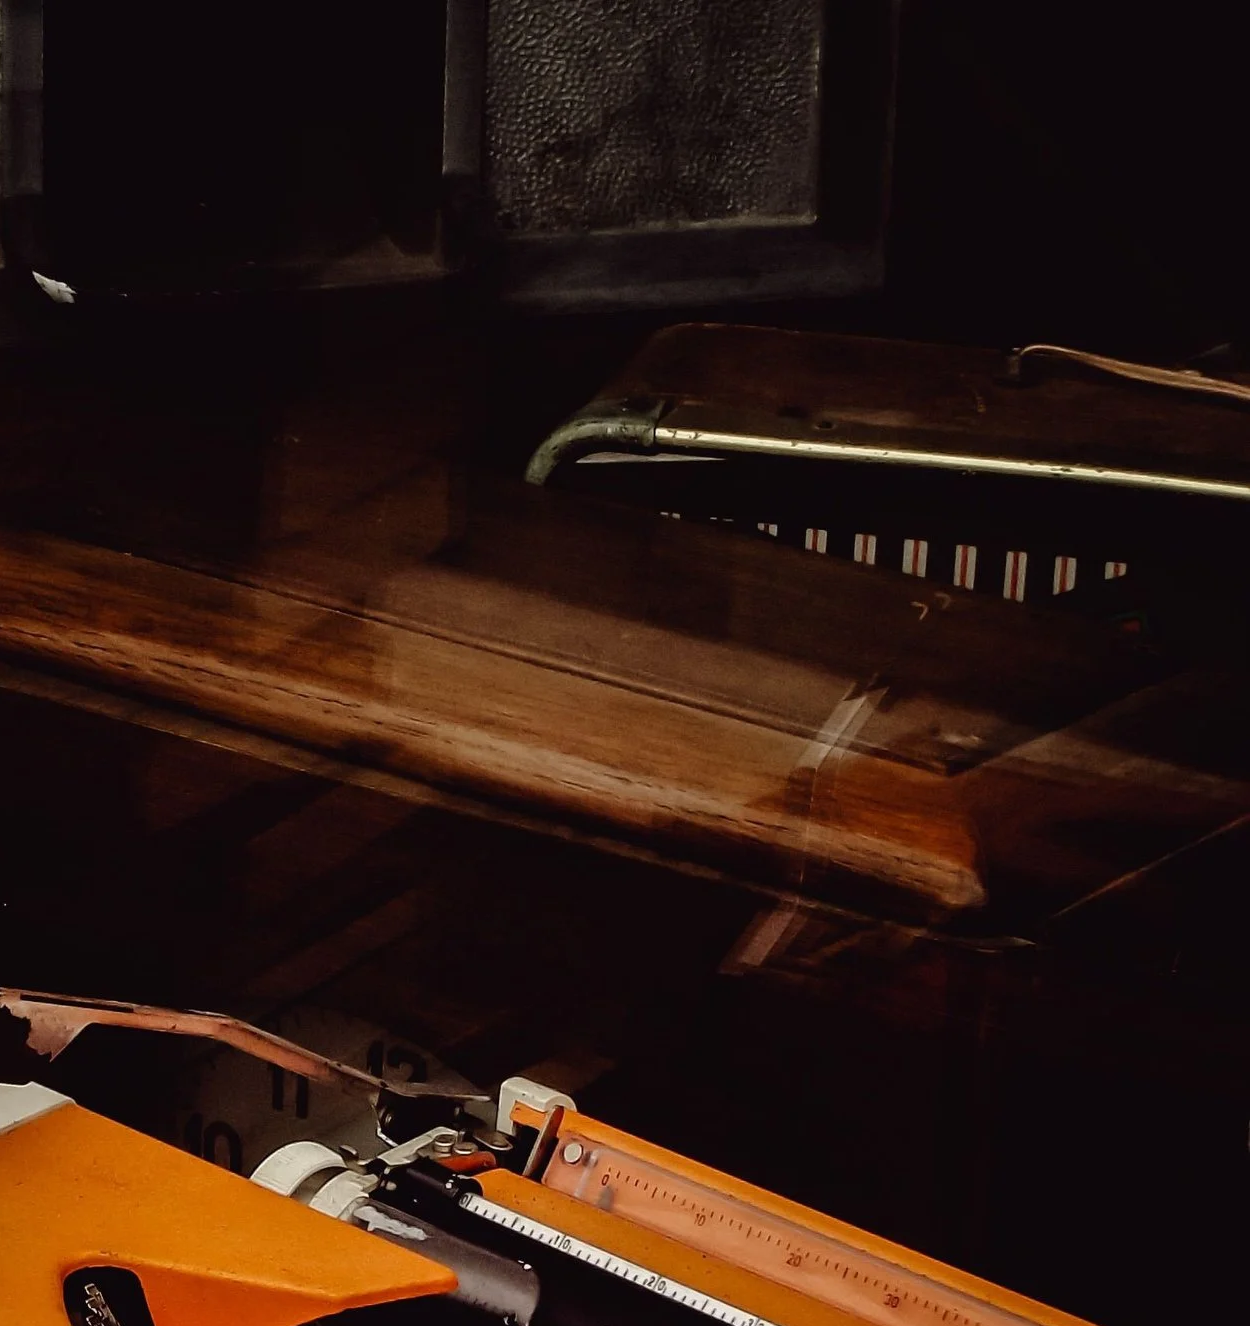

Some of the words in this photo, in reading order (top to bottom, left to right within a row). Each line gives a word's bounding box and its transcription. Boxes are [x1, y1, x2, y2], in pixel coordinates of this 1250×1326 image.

[600, 1173, 612, 1188] 0
[693, 1211, 707, 1228] 10
[785, 1252, 801, 1269] 20
[882, 1292, 901, 1310] 30
